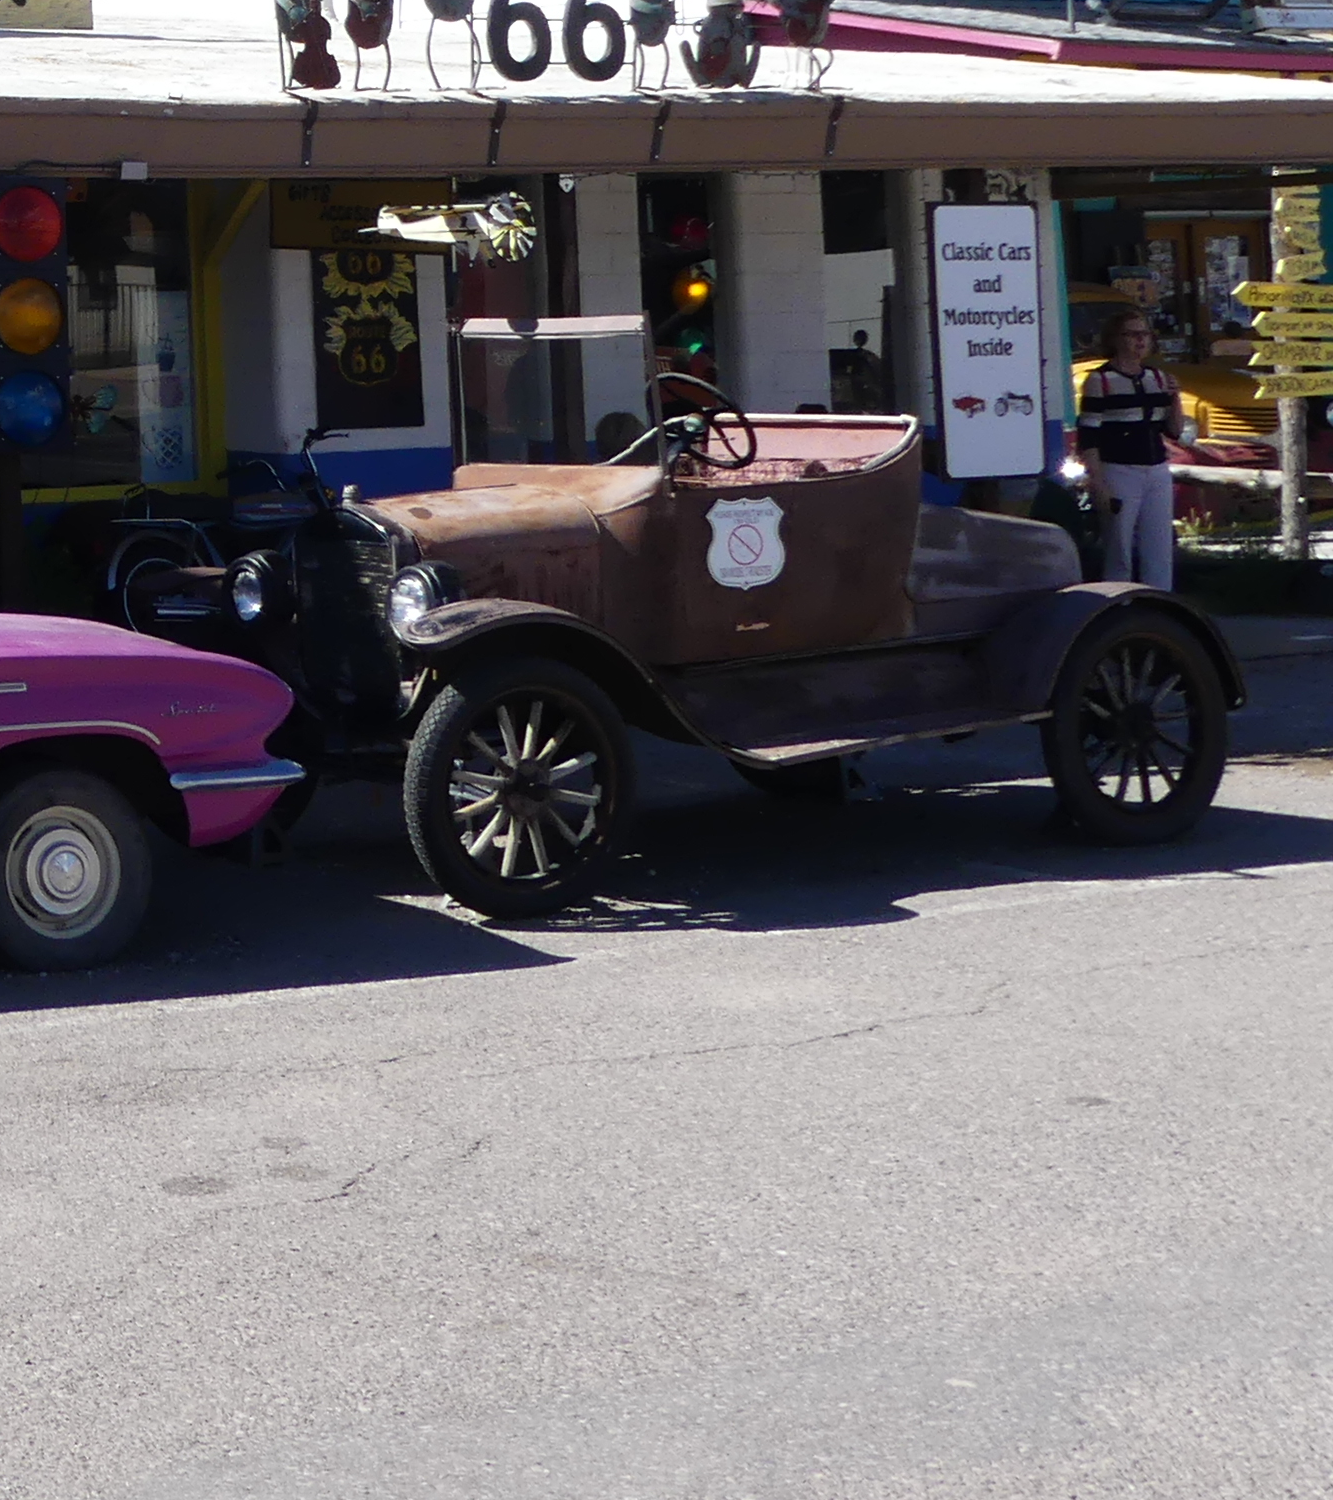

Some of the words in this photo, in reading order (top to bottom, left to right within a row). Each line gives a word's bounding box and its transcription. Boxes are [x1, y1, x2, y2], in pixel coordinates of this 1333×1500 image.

[941, 242, 993, 262] Classic
[998, 243, 1032, 261] Cars
[972, 275, 1002, 293] and
[943, 306, 1035, 330] Motorcycles
[967, 338, 1013, 358] Inside
[351, 343, 387, 375] 66
